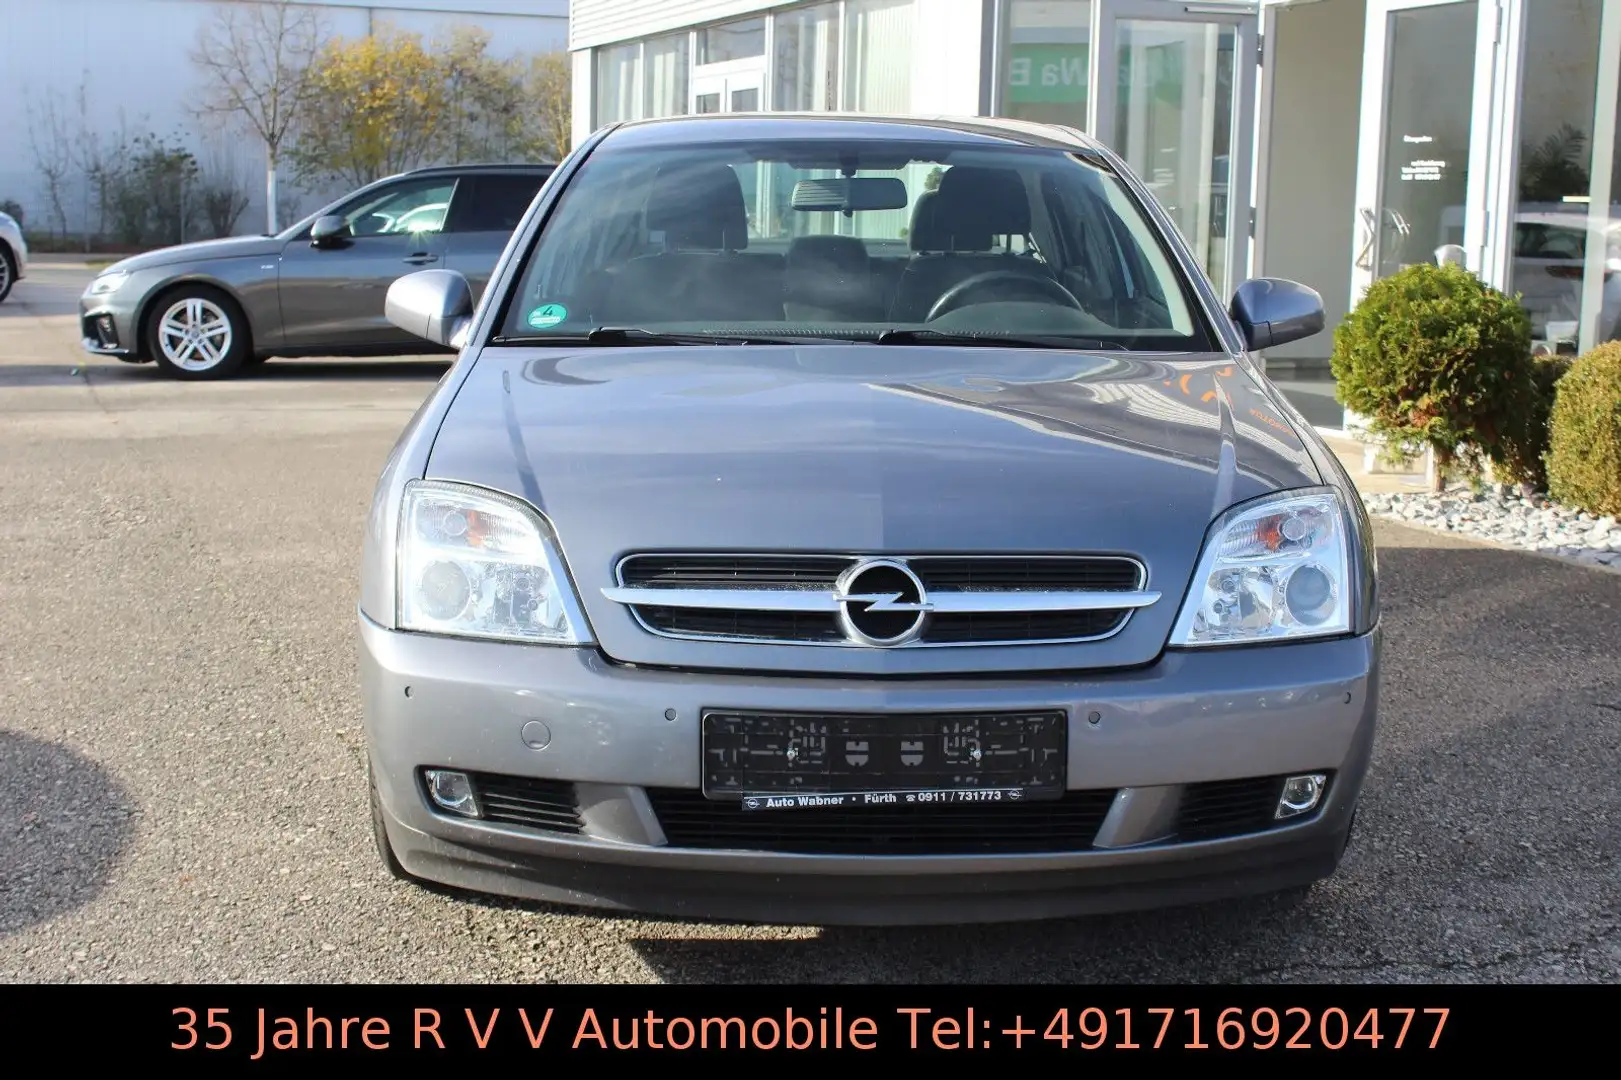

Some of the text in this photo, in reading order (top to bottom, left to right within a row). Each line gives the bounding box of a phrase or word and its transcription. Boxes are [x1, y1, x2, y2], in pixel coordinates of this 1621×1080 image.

[543, 306, 553, 316] 4
[766, 799, 794, 808] Auto
[798, 796, 844, 806] Wabner
[864, 793, 897, 804] Fürth
[918, 792, 946, 802] 0911
[958, 791, 1002, 801] 731773
